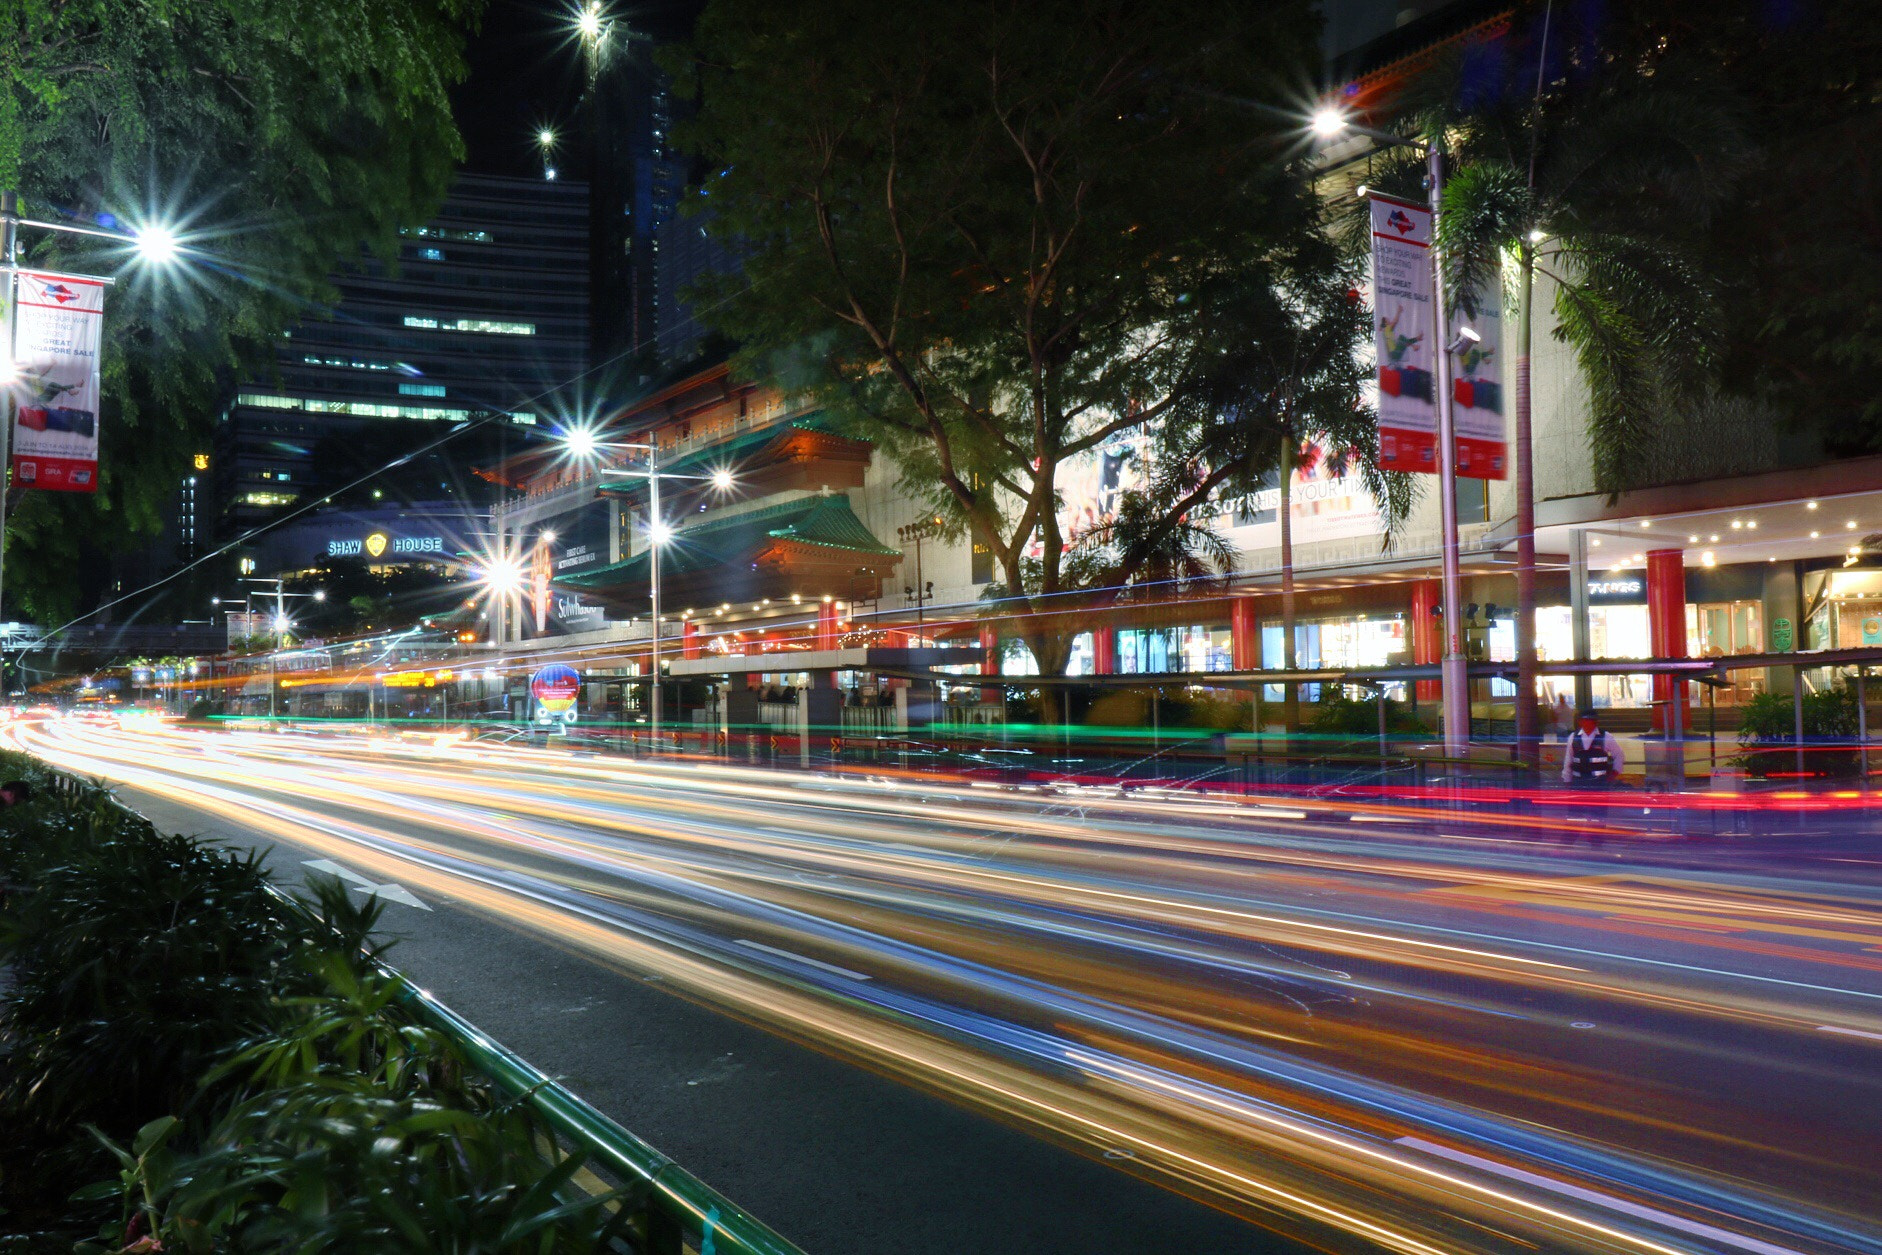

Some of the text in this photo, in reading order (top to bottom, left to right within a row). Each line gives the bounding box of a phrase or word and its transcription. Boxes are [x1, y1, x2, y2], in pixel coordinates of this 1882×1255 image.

[27, 343, 95, 357] NGAPORE SALE
[43, 338, 71, 347] GREAT
[1297, 480, 1337, 500] YOUR
[328, 537, 442, 556] SHAW HOUSE
